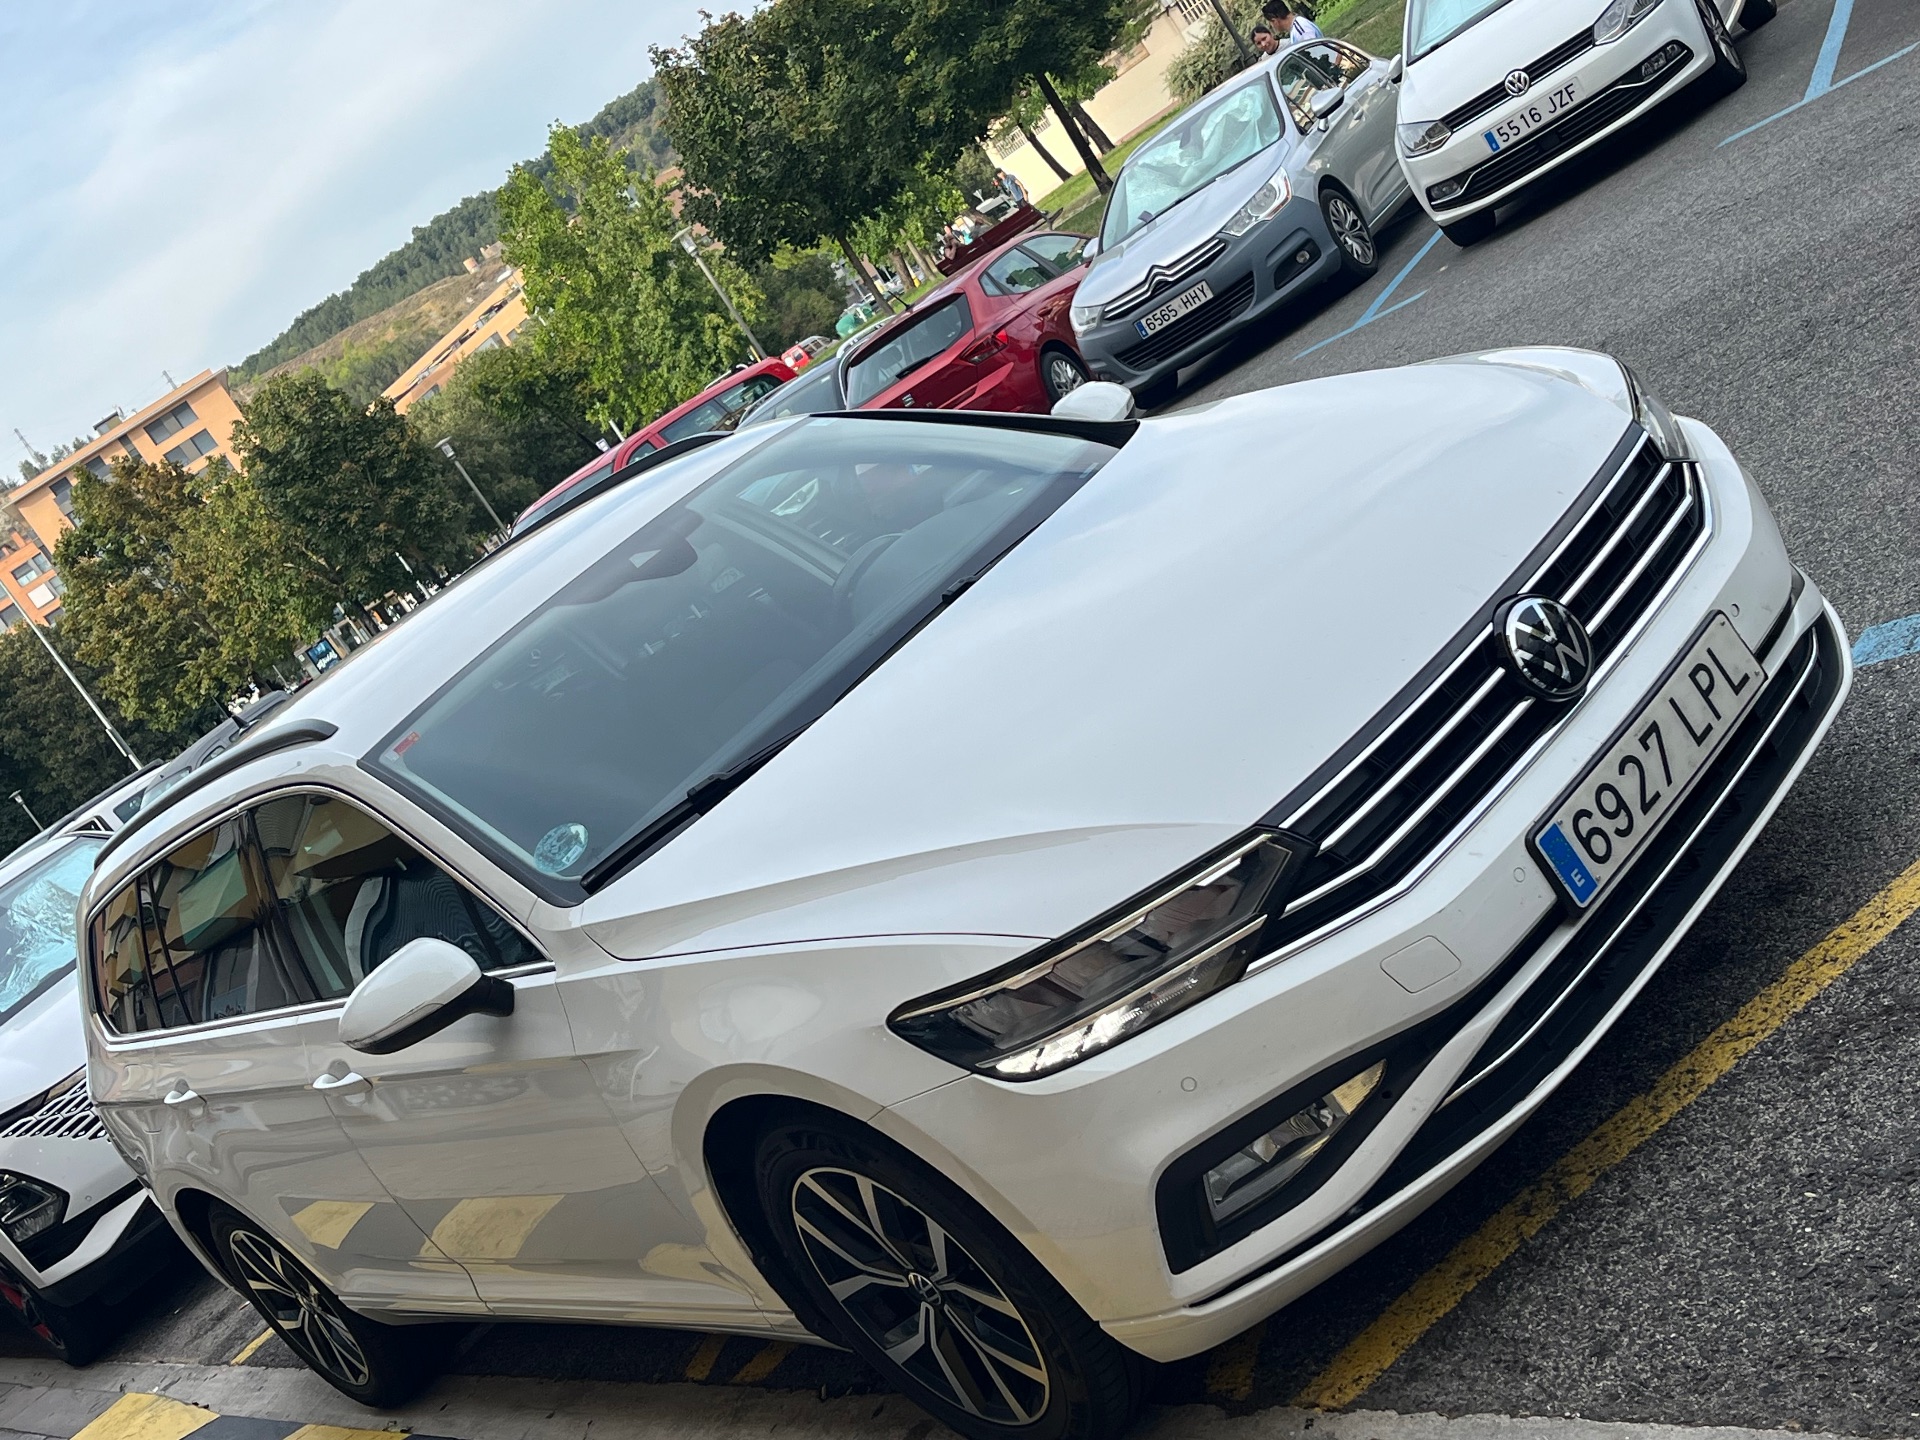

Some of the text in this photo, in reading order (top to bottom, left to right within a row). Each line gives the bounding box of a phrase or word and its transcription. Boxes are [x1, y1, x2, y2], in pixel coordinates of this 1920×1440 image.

[1496, 83, 1576, 143] 5516 JZF
[1145, 284, 1208, 331] 6565 HHY
[1572, 647, 1750, 865] 6927 LPL
[1570, 868, 1586, 888] E
